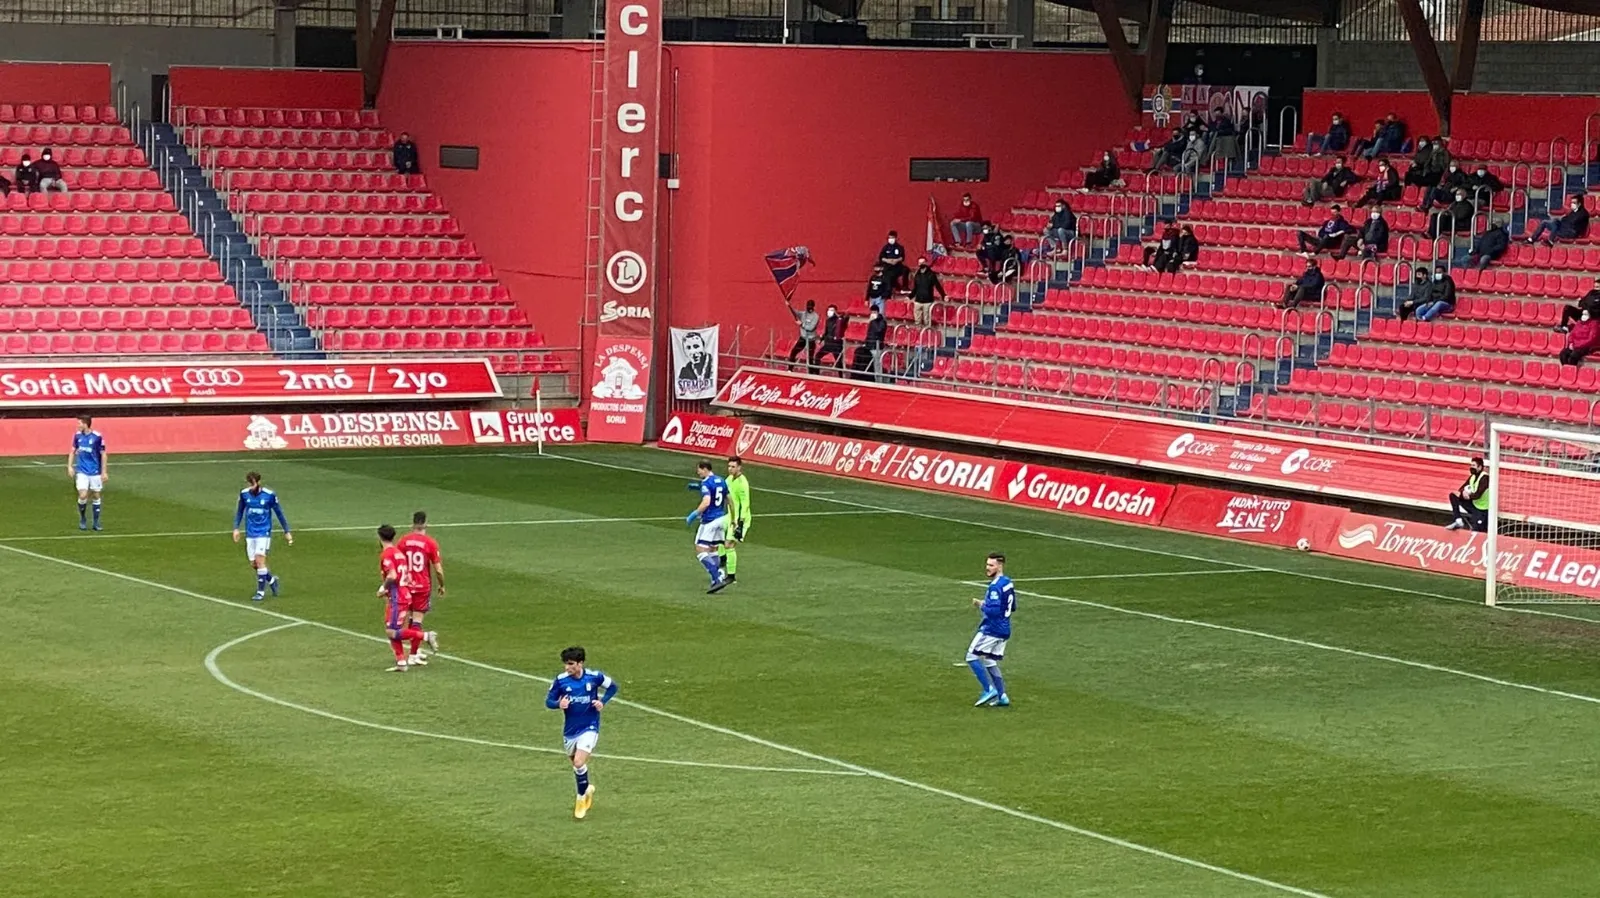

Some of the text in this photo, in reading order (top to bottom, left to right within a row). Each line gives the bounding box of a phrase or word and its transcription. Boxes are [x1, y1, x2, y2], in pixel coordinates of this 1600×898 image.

[605, 343, 649, 370] DESPENSA
[1, 373, 173, 396] Soria Motor
[387, 368, 448, 394] 2yo
[751, 385, 832, 411] Caja Soria
[281, 412, 460, 435] LA DESPENSA
[506, 411, 554, 424] Grupo
[605, 415, 626, 424] SORIA
[508, 425, 575, 442] Herce
[690, 421, 734, 438] Diputación
[302, 433, 443, 448] TORREZNOS DE SORIA
[684, 433, 718, 448] de Soria
[1187, 443, 1220, 456] COPE
[1303, 458, 1337, 472] COPE
[715, 487, 722, 507] 5
[1027, 473, 1156, 517] Grupo Losán
[1260, 500, 1291, 511] TUTTO
[1374, 521, 1453, 568] Torrezno
[1453, 530, 1477, 564] de
[406, 551, 424, 572] 19
[1005, 594, 1013, 617] 3
